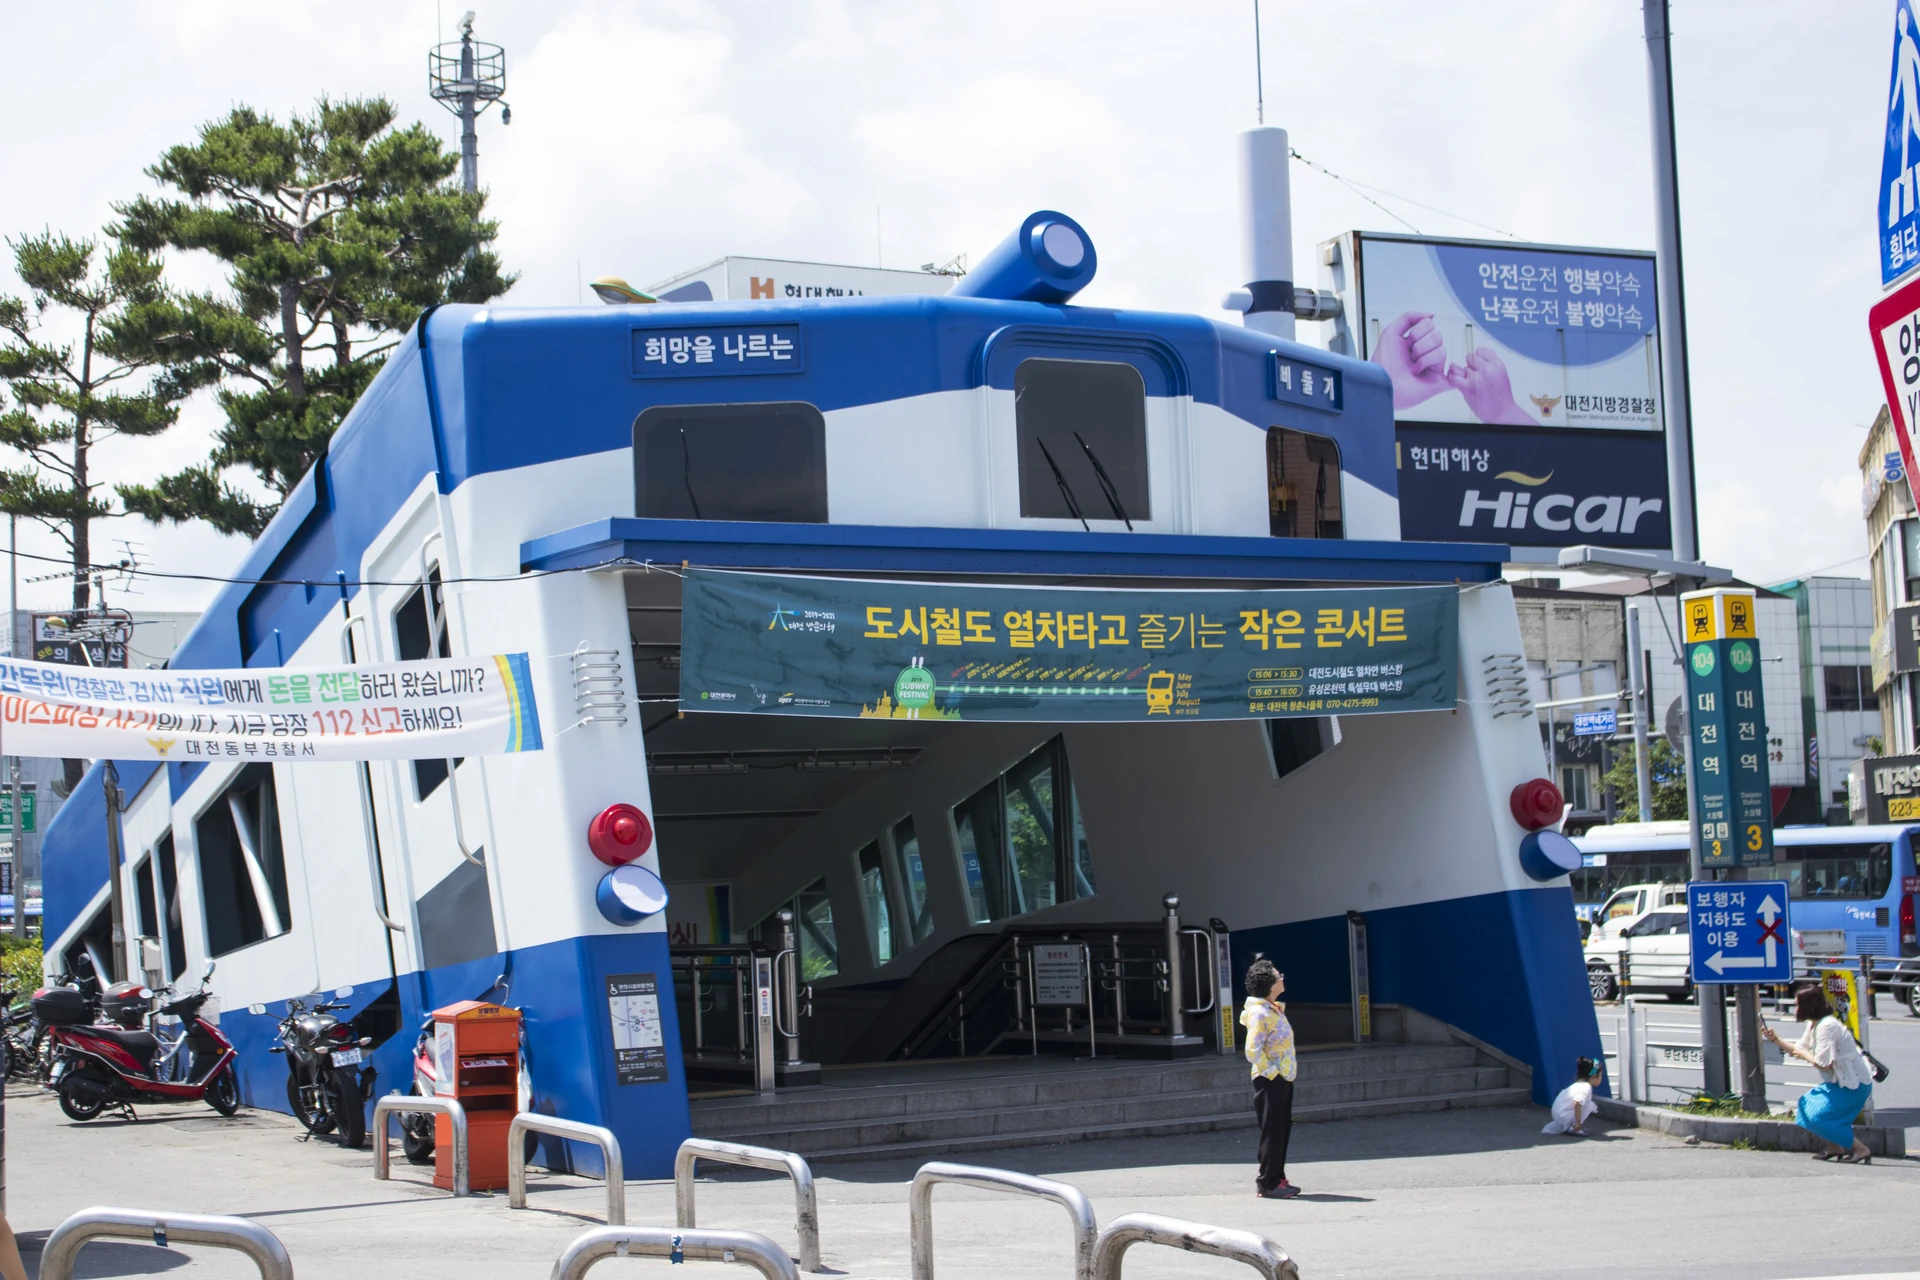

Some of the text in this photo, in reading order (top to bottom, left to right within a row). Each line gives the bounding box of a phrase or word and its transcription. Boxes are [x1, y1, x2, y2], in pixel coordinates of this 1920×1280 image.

[1479, 263, 1641, 298] 안전운전 행복약속
[1481, 296, 1643, 330] 난폭운전 불행약속
[645, 334, 794, 364] 희망을 나르는
[1280, 365, 1335, 401] 비둘기
[1565, 395, 1656, 415] 대전지방경찰청
[1410, 446, 1490, 472] 현대해상
[1459, 489, 1663, 534] Hicar
[804, 611, 835, 620] 2019~2021
[788, 621, 804, 631] 대전
[864, 606, 1407, 650] 도시철도 열차타고 즐기는 작은 콘서트
[1693, 653, 1715, 669] 104
[1730, 649, 1753, 665] 104
[1178, 673, 1192, 682] May
[1255, 669, 1298, 679] 15:06 15:30
[1308, 664, 1403, 679] 대전도시철도 열차안 버스킹
[177, 676, 264, 705] 직원에게
[267, 674, 312, 704] 돈을
[316, 671, 397, 703] 전달하러
[401, 667, 485, 698] 왔습니까?
[1176, 690, 1189, 698] July
[1280, 687, 1298, 696] 16:00
[1308, 680, 1403, 695] 유성온천역 특설무대 버스킹
[900, 691, 930, 699] FESTIVAL
[1176, 698, 1201, 706] August
[1267, 702, 1288, 712] 대전역
[1326, 698, 1379, 709] 070-4275-9993
[226, 713, 267, 736] 지금
[269, 713, 308, 737] 당장
[312, 709, 356, 737] 112
[361, 705, 462, 736] 신고하세요!
[1698, 692, 1719, 775] 대전역
[1736, 690, 1758, 772] 대전역
[186, 740, 315, 757] 대전동부경찰서
[1703, 795, 1723, 803] Daejeon
[1741, 792, 1761, 800] Daejeon
[1890, 801, 1920, 817] 223-
[1747, 825, 1763, 851] 3
[1712, 840, 1722, 856] 3
[1696, 891, 1746, 908] 보행자
[1698, 911, 1747, 928] 지하도
[1707, 931, 1740, 948] 이용
